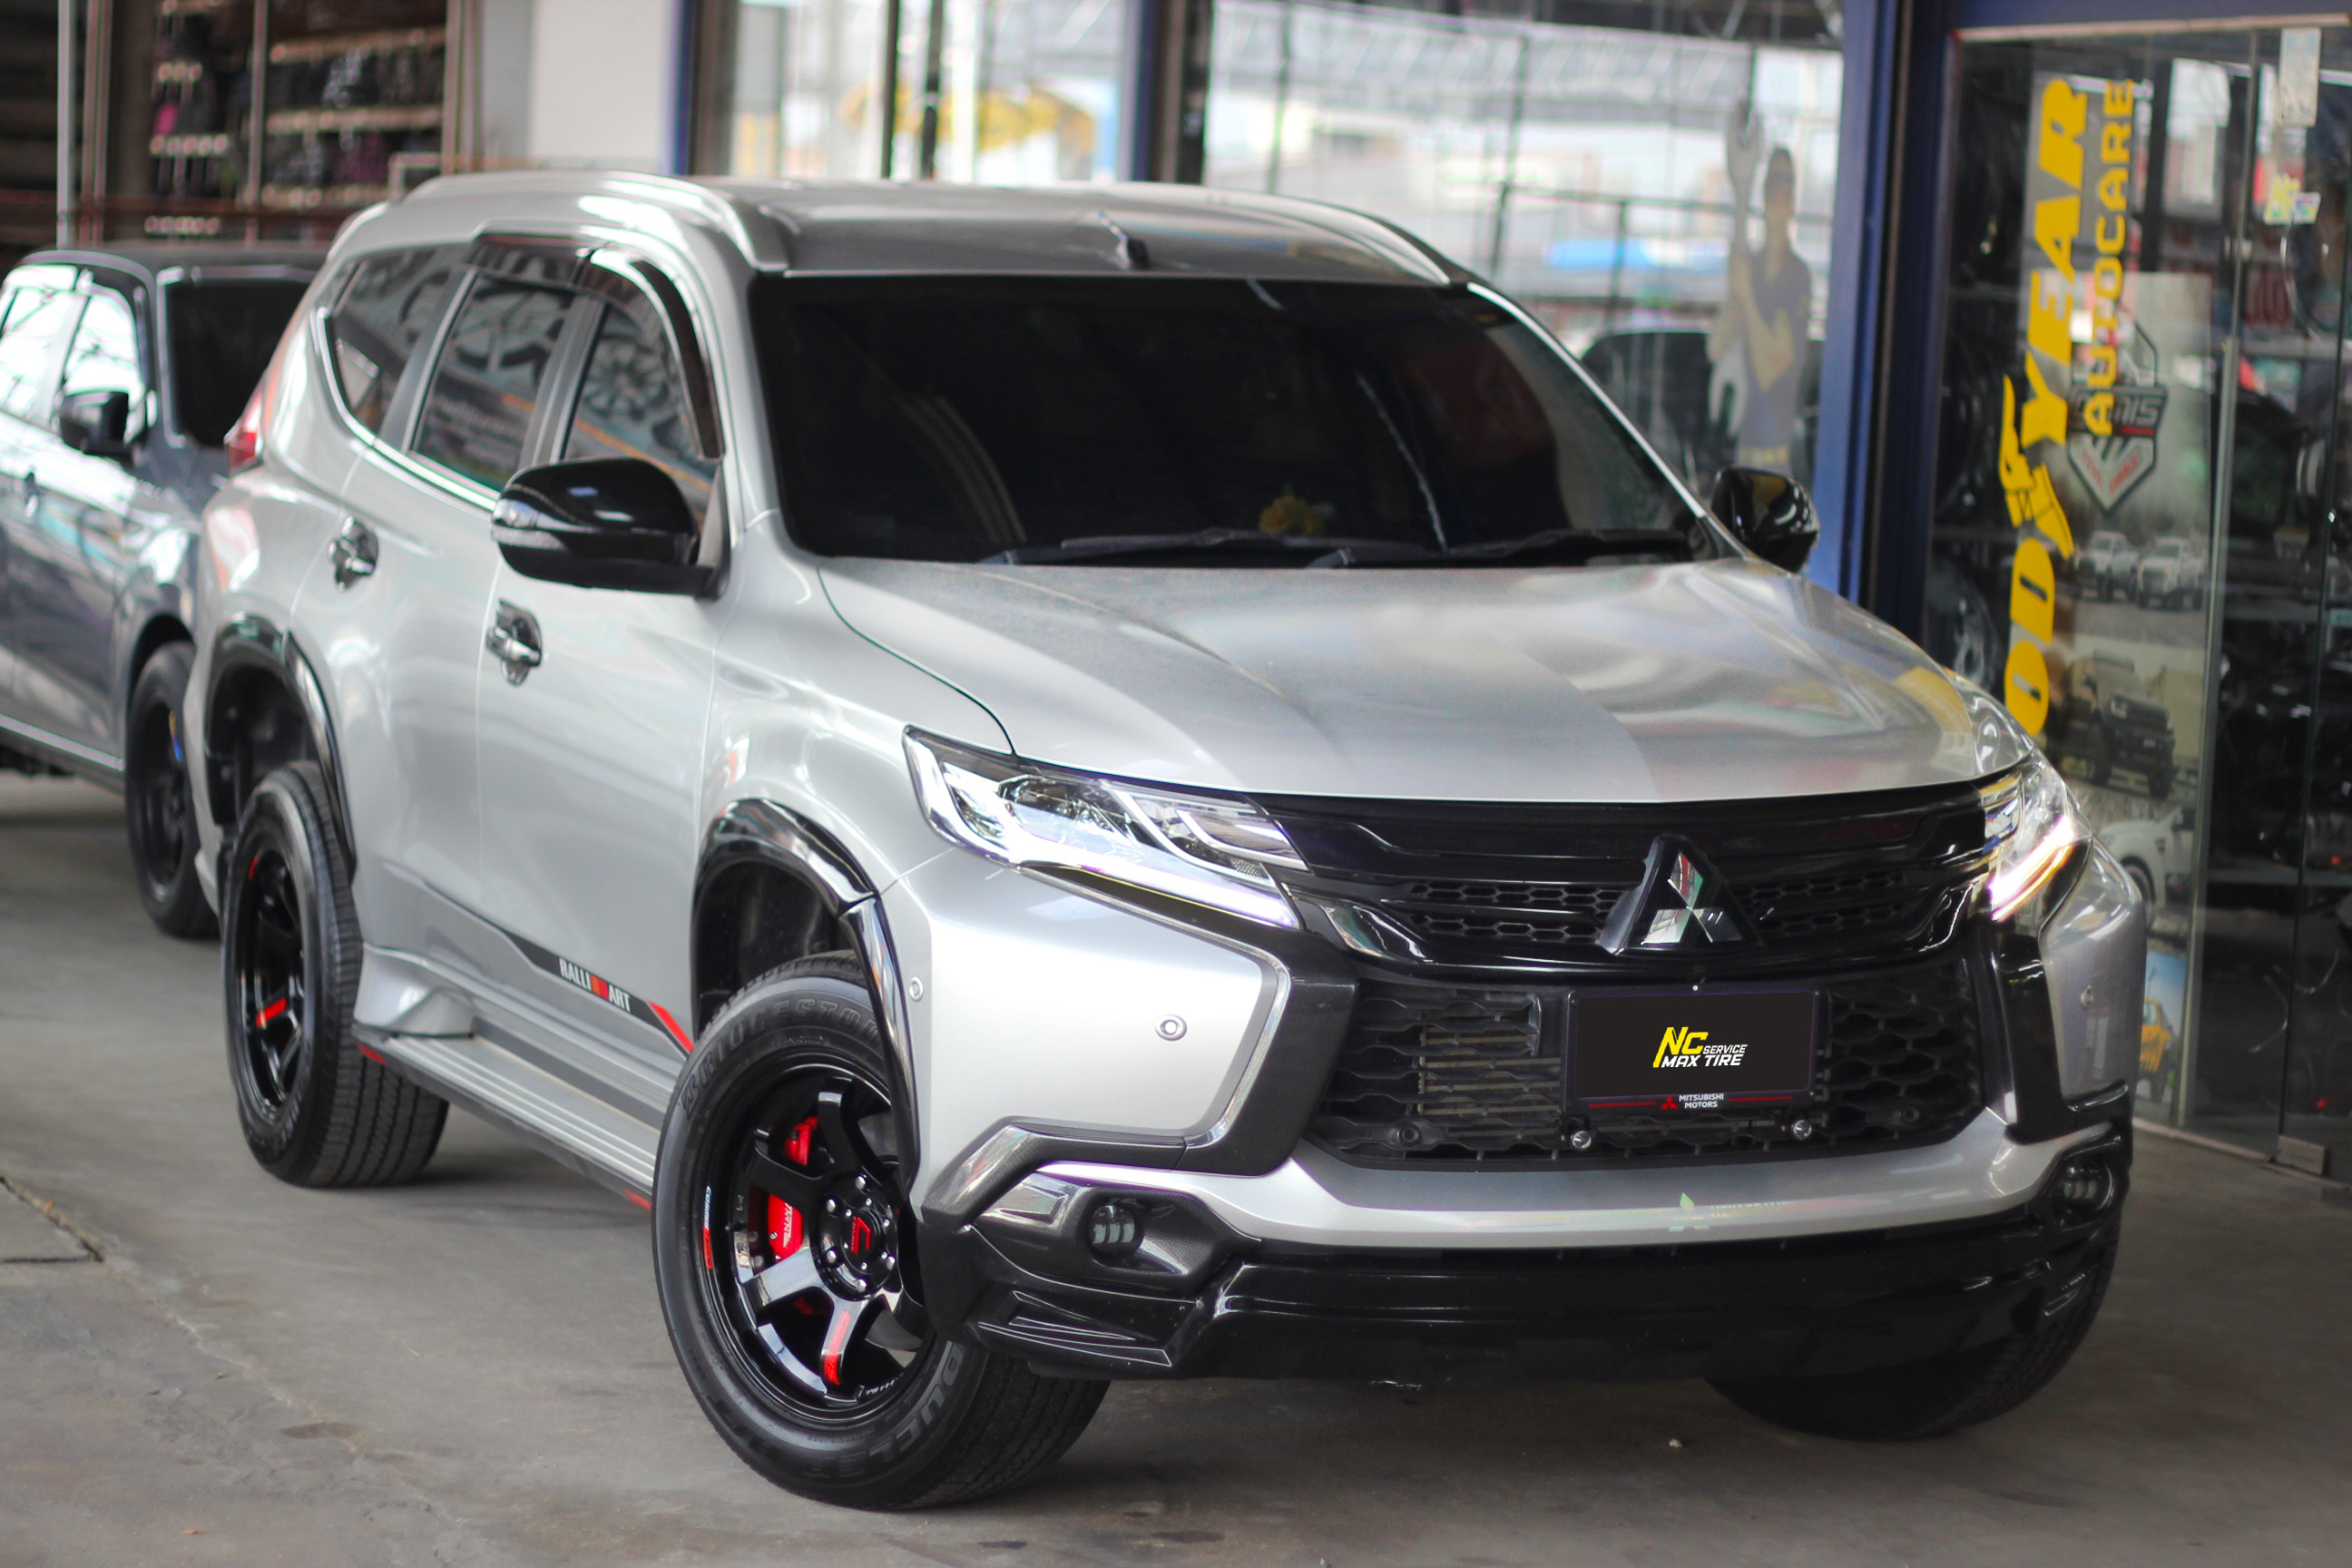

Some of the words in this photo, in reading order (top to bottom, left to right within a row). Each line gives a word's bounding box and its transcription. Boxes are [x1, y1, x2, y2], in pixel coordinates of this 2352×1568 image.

[2083, 79, 2133, 436] AUTOCARE
[559, 957, 592, 991] RALLI
[608, 985, 632, 1013] ART
[681, 998, 883, 1121] BRIDGESTON
[1679, 1093, 1724, 1102] MITSUBISHI
[1684, 1101, 1718, 1109] MOTORS
